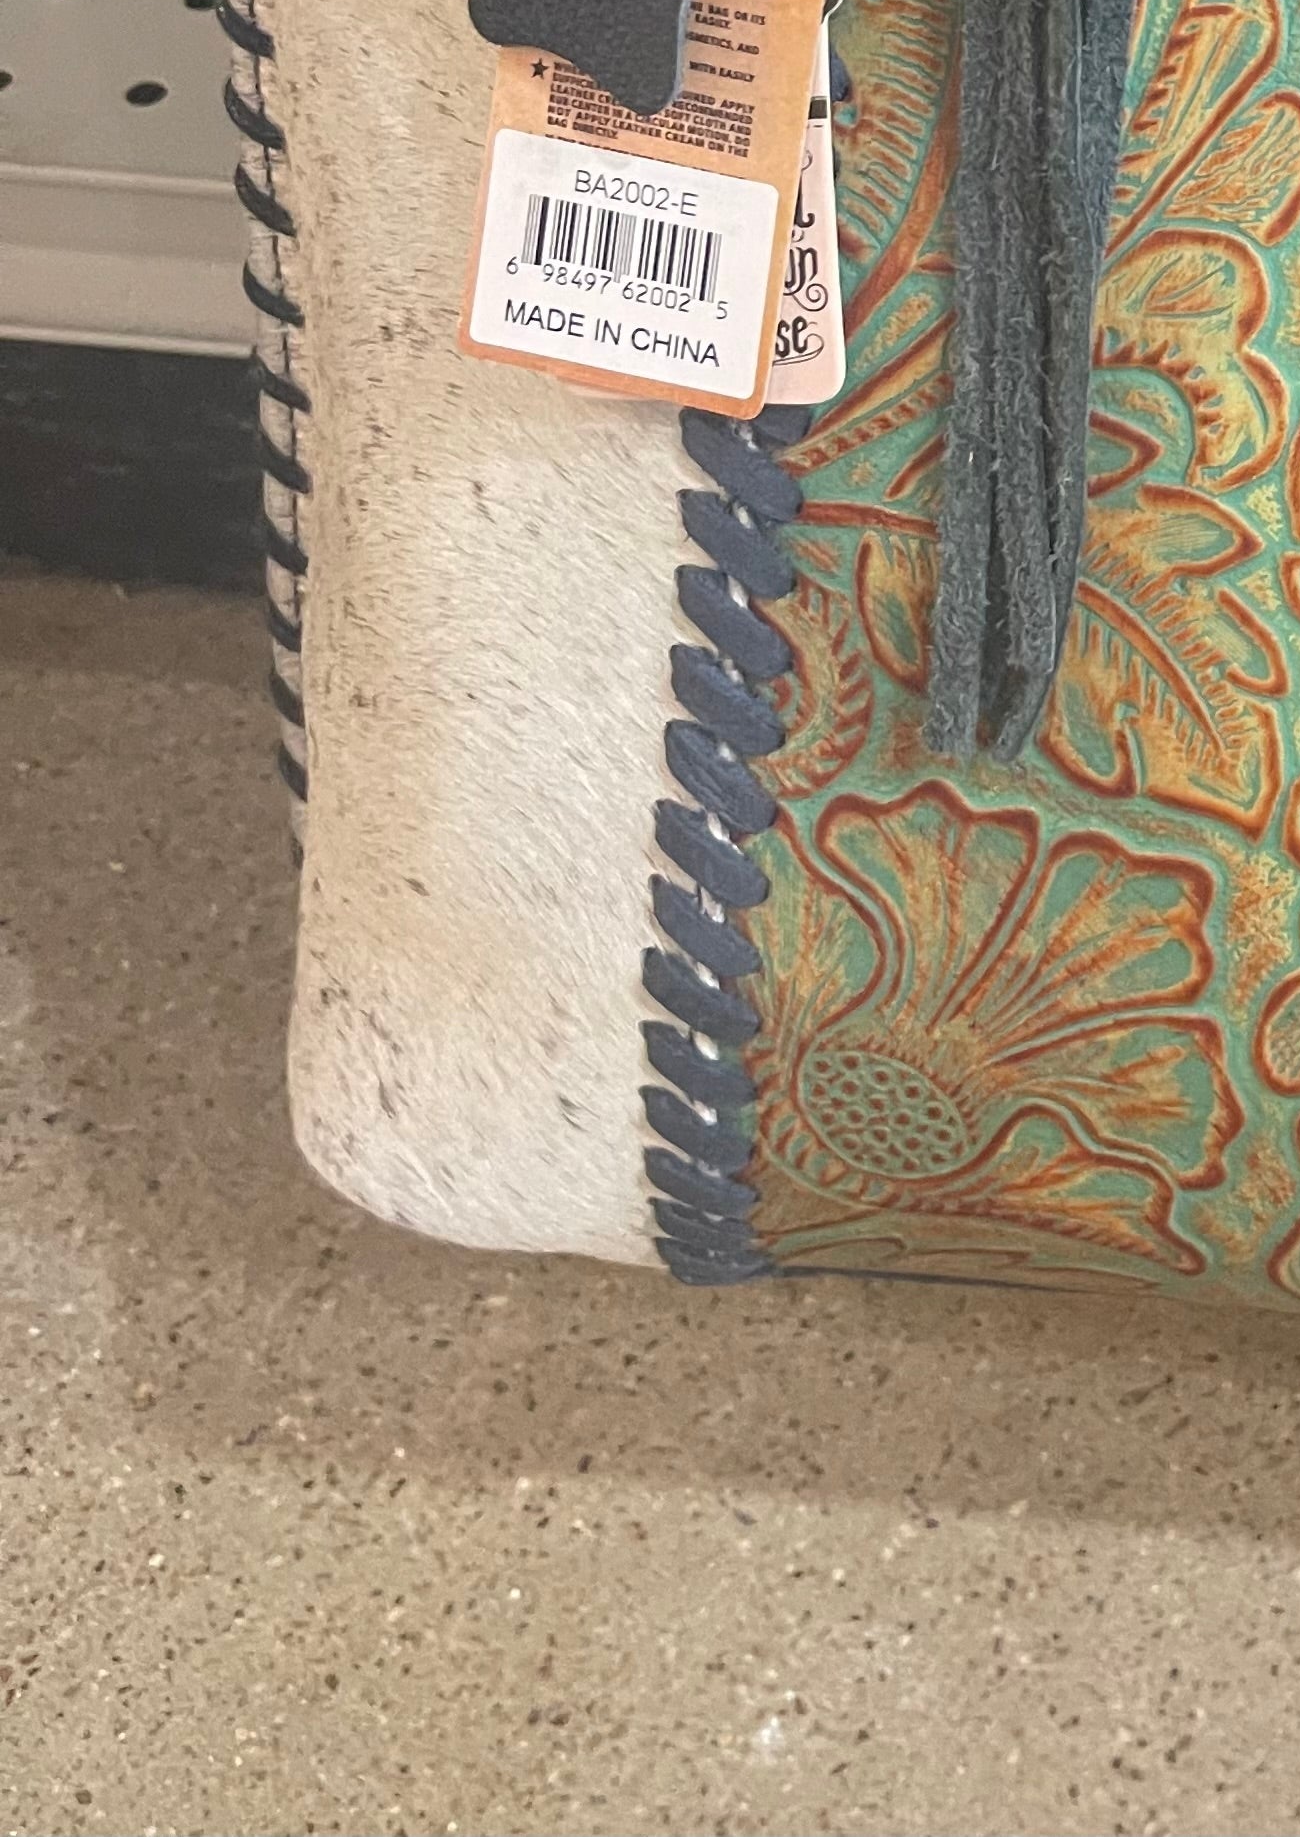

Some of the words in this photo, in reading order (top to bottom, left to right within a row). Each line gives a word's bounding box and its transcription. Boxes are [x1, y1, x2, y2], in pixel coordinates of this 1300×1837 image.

[708, 4, 729, 17] BAG
[685, 31, 734, 51] SMETICS,
[737, 43, 760, 55] AND
[547, 116, 568, 128] BAG
[550, 83, 596, 100] LEATHER
[693, 115, 727, 130] CLOTH
[729, 123, 752, 136] AND
[625, 111, 633, 119] A
[720, 99, 756, 114] APPLY
[547, 105, 572, 117] NOT
[575, 111, 611, 126] APPLY
[612, 119, 662, 138] LEATHER
[665, 131, 705, 148] CREAM
[708, 141, 725, 152] ON
[728, 145, 748, 158] THE
[574, 169, 699, 217] BA2002-E
[506, 256, 519, 275] 6
[543, 263, 612, 295] 98497
[622, 281, 692, 313] 62002
[716, 300, 729, 320] 5
[504, 299, 586, 338] MADE
[594, 318, 622, 346] IN
[631, 327, 720, 368] CHINA
